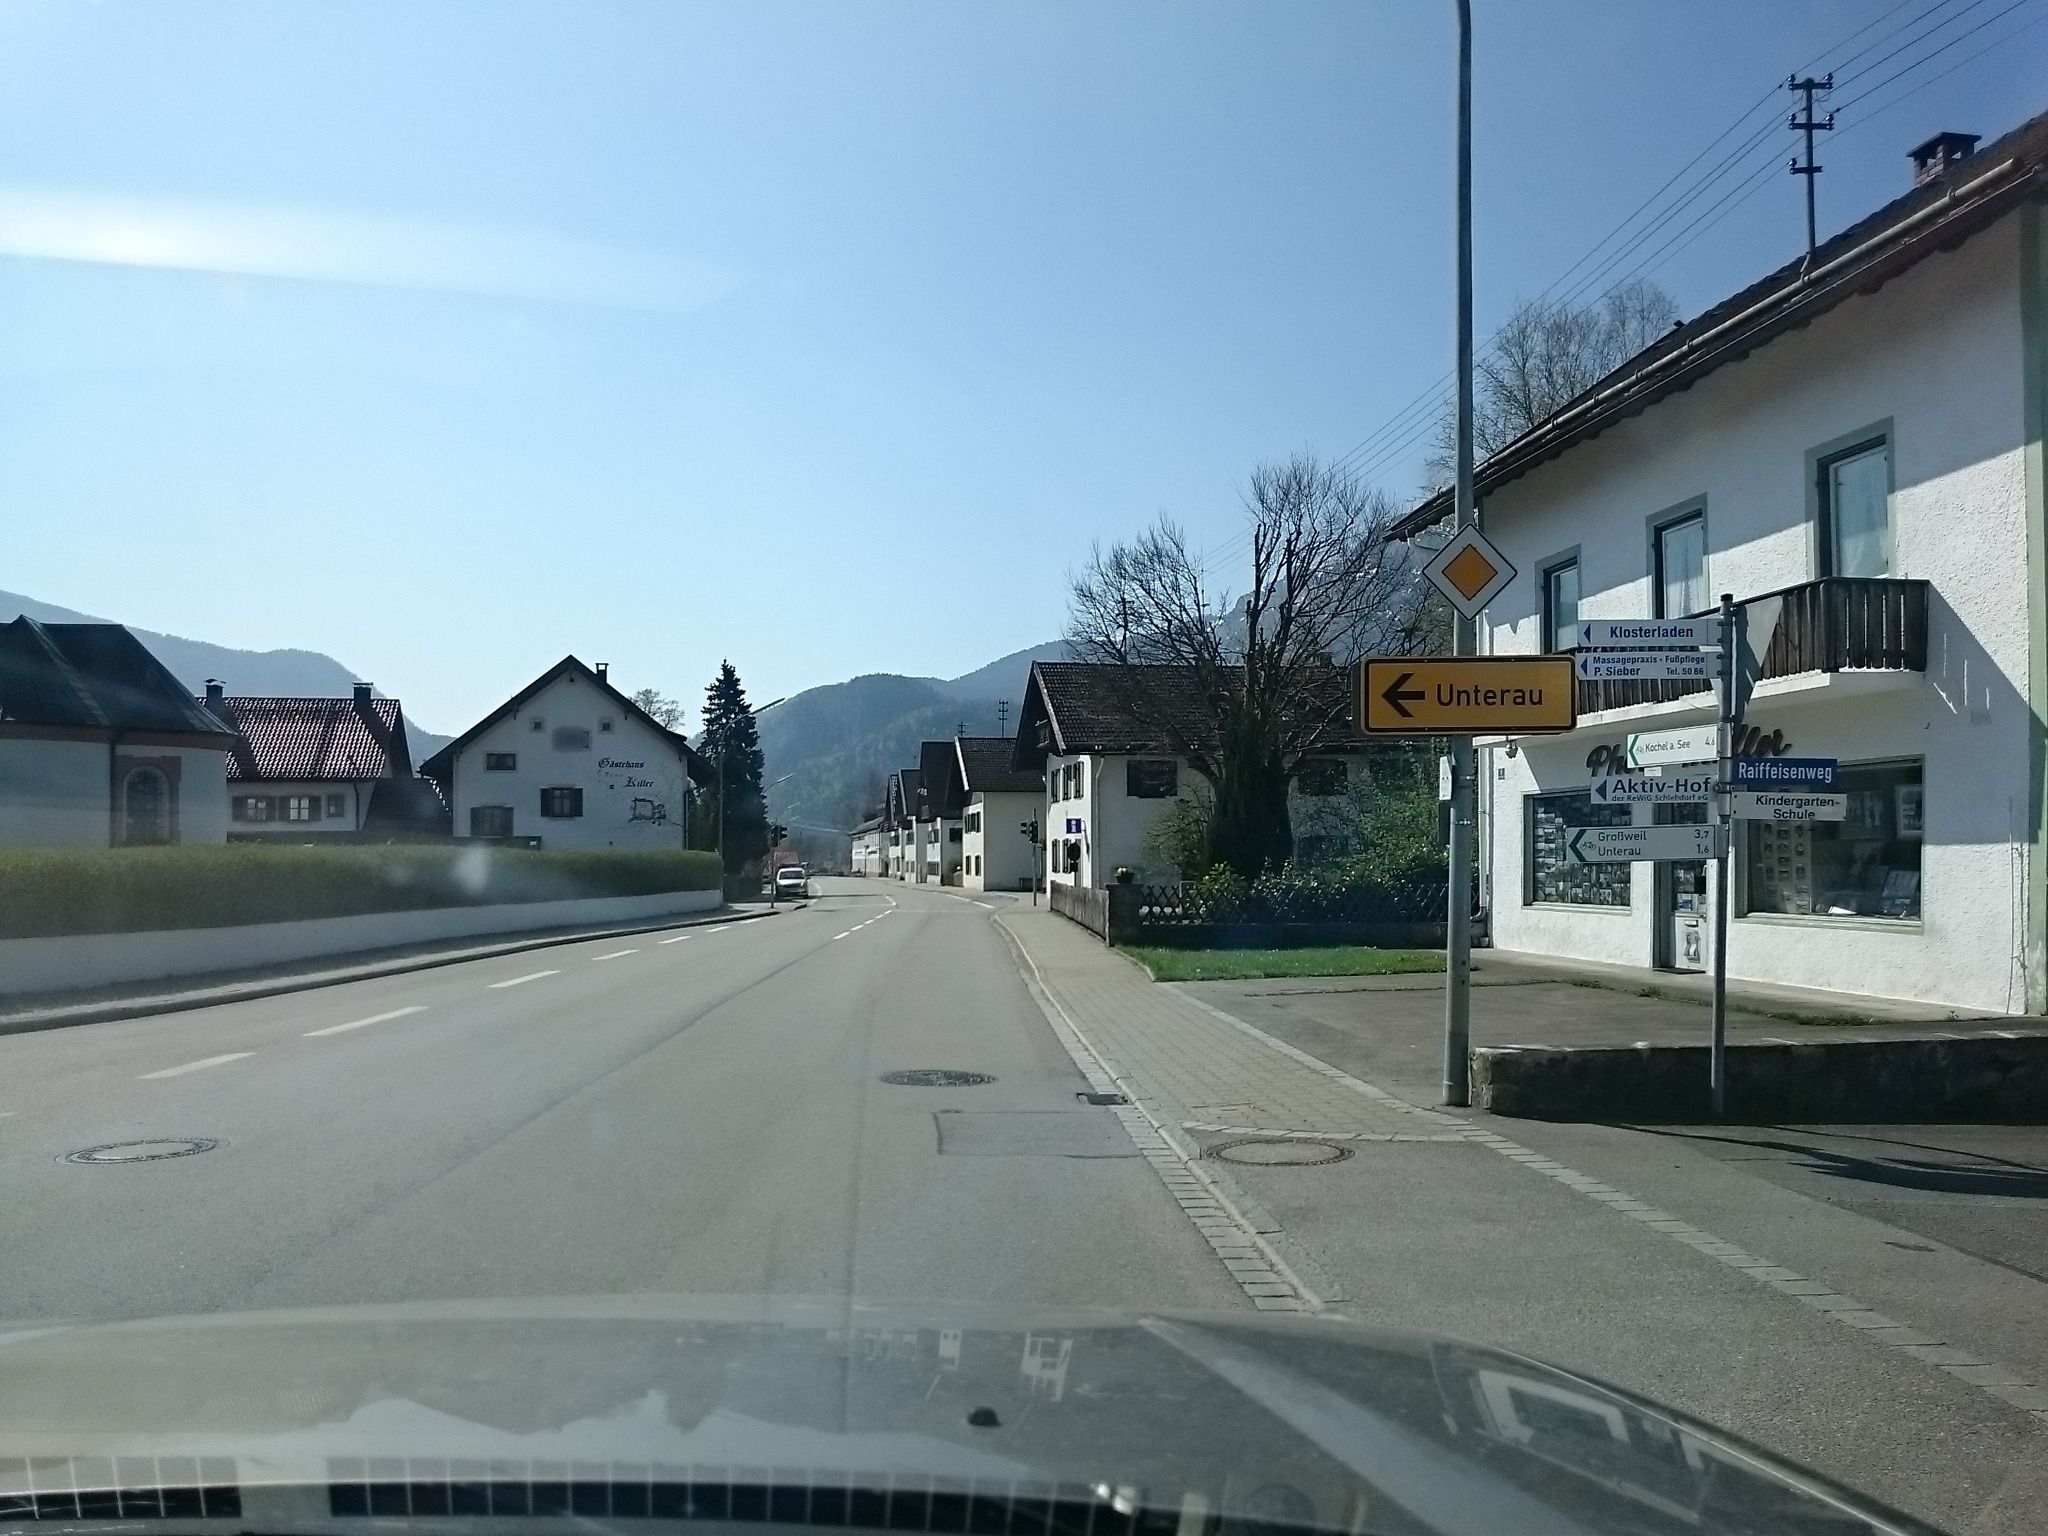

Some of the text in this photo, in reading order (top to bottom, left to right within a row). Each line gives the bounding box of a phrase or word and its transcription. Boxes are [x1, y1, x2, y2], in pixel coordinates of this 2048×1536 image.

[1609, 625, 1694, 638] Klosterladen
[1592, 655, 1658, 666] Massagepraxis
[1593, 666, 1641, 677] P. Sieber
[1666, 667, 1680, 676] Tel.
[1435, 683, 1544, 707] Unterau
[1645, 741, 1669, 753] Kochel
[1677, 739, 1691, 750] See
[1738, 762, 1832, 783] Raiffeisenweg
[1612, 777, 1711, 794] Aktiv-Hof
[1612, 794, 1625, 802] der
[1755, 795, 1840, 808] Kindergarten-
[1773, 808, 1816, 820] Schule
[1598, 830, 1647, 842] Großweil
[1598, 846, 1641, 856] Unterau
